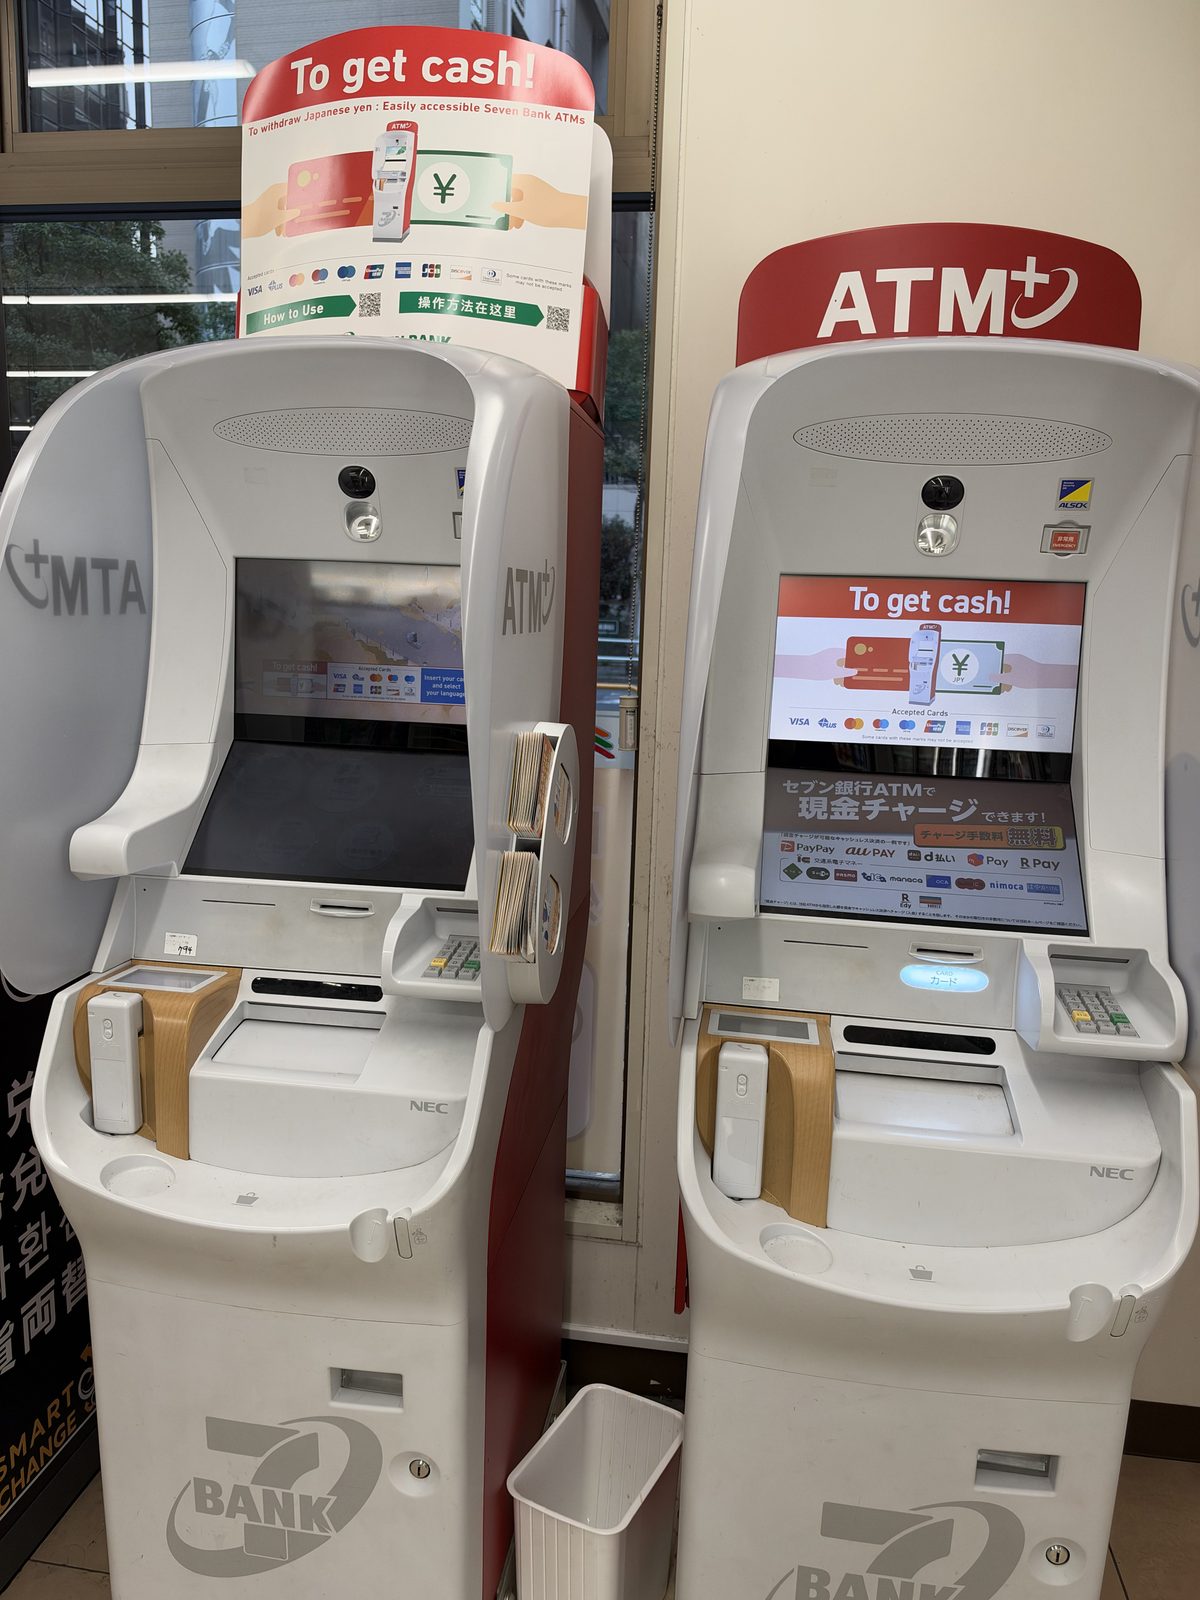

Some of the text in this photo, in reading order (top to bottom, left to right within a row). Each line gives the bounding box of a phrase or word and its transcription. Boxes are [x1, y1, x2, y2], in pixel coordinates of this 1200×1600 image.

[291, 49, 536, 95] To get cash!
[248, 127, 259, 137] To
[260, 115, 301, 134] withdraw
[304, 106, 350, 122] Japanese
[353, 104, 372, 115] yen
[383, 101, 417, 112] Easily
[420, 101, 480, 112] accessible
[484, 103, 518, 116] Seven
[522, 107, 551, 120] Bank
[554, 112, 586, 125] ATMs
[247, 285, 263, 297] VISA
[263, 303, 324, 325] How to Use
[417, 296, 516, 319] 操作方法在这里
[849, 586, 1011, 618] To get cash!
[891, 708, 949, 718] Accepted Cards
[788, 717, 810, 726] VISA
[782, 778, 936, 797] セブン銀行ATMで
[798, 796, 979, 822] 現金チャージ
[920, 826, 1056, 847] チャージ手数料 無料
[796, 842, 835, 855] PayPay
[845, 846, 896, 858] au PAY
[924, 851, 956, 863] d払い
[986, 856, 1009, 868] Pay
[1033, 858, 1061, 871] Pay
[889, 876, 924, 884] manaca
[989, 882, 1024, 891] nimoca
[930, 976, 958, 987] カード
[409, 1100, 449, 1115] NEC
[1089, 1165, 1135, 1182] NEC
[193, 1476, 338, 1534] BANK
